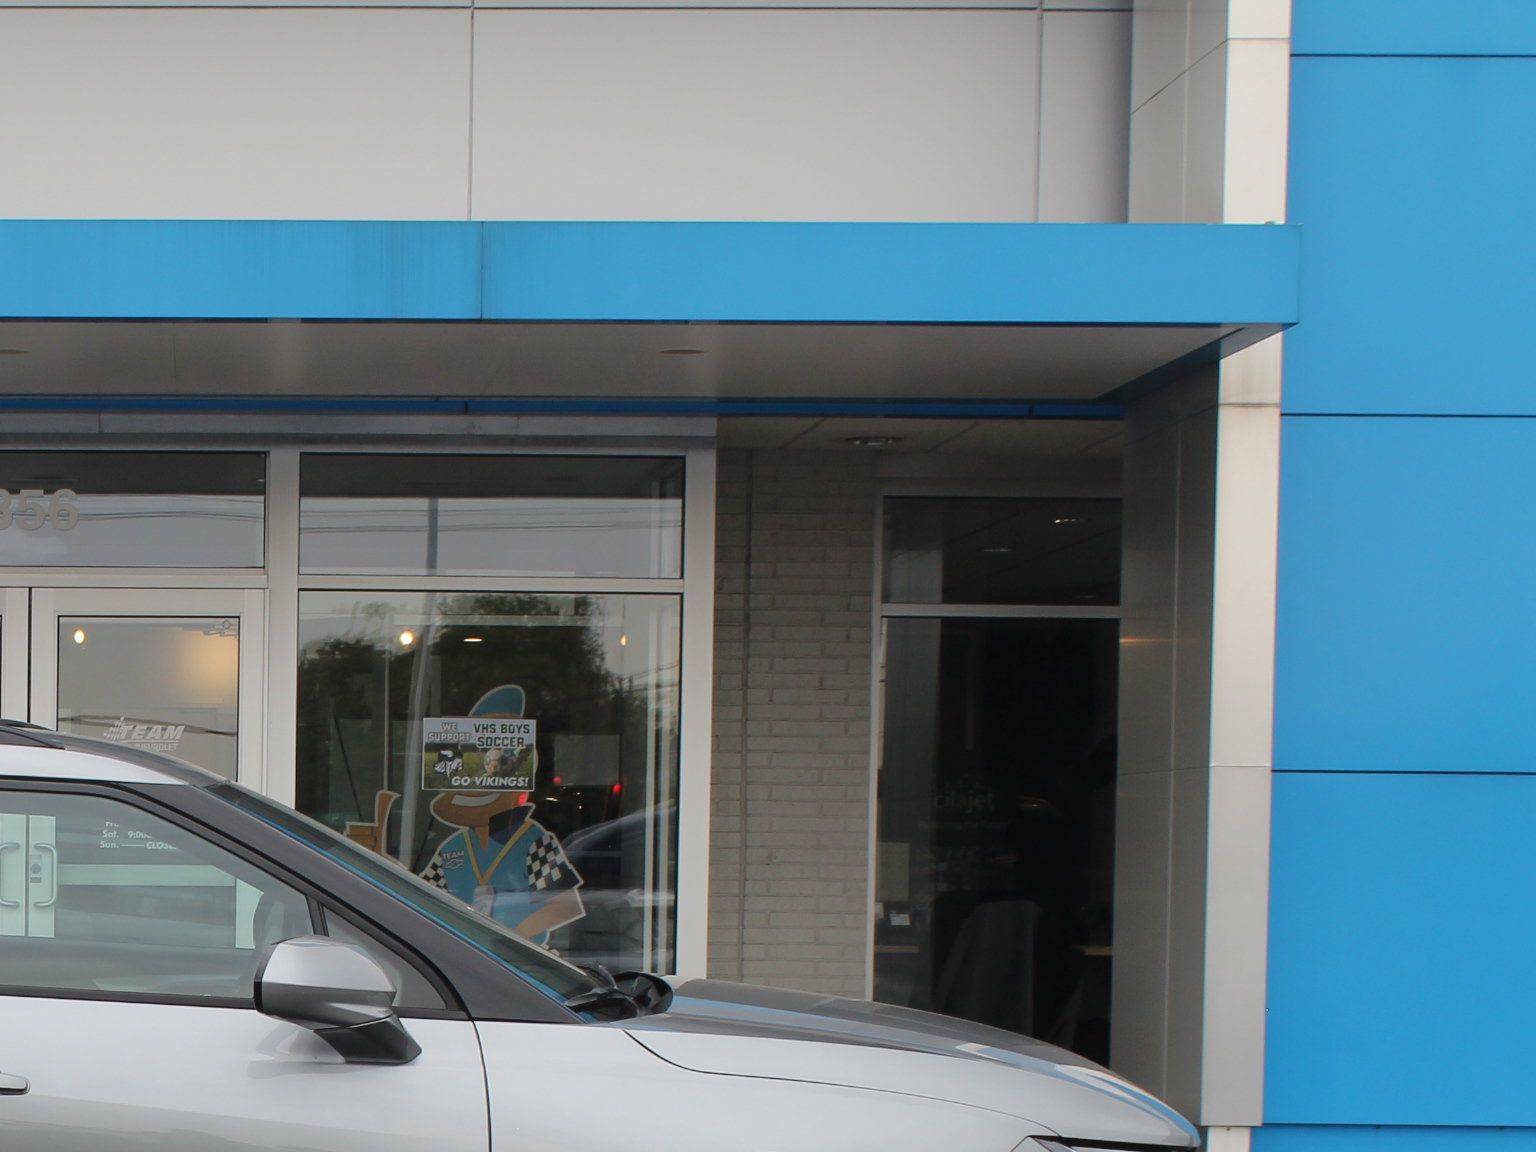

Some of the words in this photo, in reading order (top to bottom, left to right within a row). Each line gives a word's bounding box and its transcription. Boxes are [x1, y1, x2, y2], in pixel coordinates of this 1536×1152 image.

[120, 725, 185, 739] TEAM
[441, 722, 457, 732] WE
[473, 723, 496, 734] VHS
[500, 723, 530, 734] BOYS
[427, 732, 470, 742] SUPPORT
[477, 736, 525, 748] SOCCER
[135, 743, 178, 751] HEVROLET
[451, 776, 470, 786] GO
[474, 776, 529, 787] VIKINGS!
[102, 830, 119, 839] Sat.
[99, 840, 119, 849] Sun.
[146, 841, 177, 850] CLOS
[442, 850, 465, 860] TEAM
